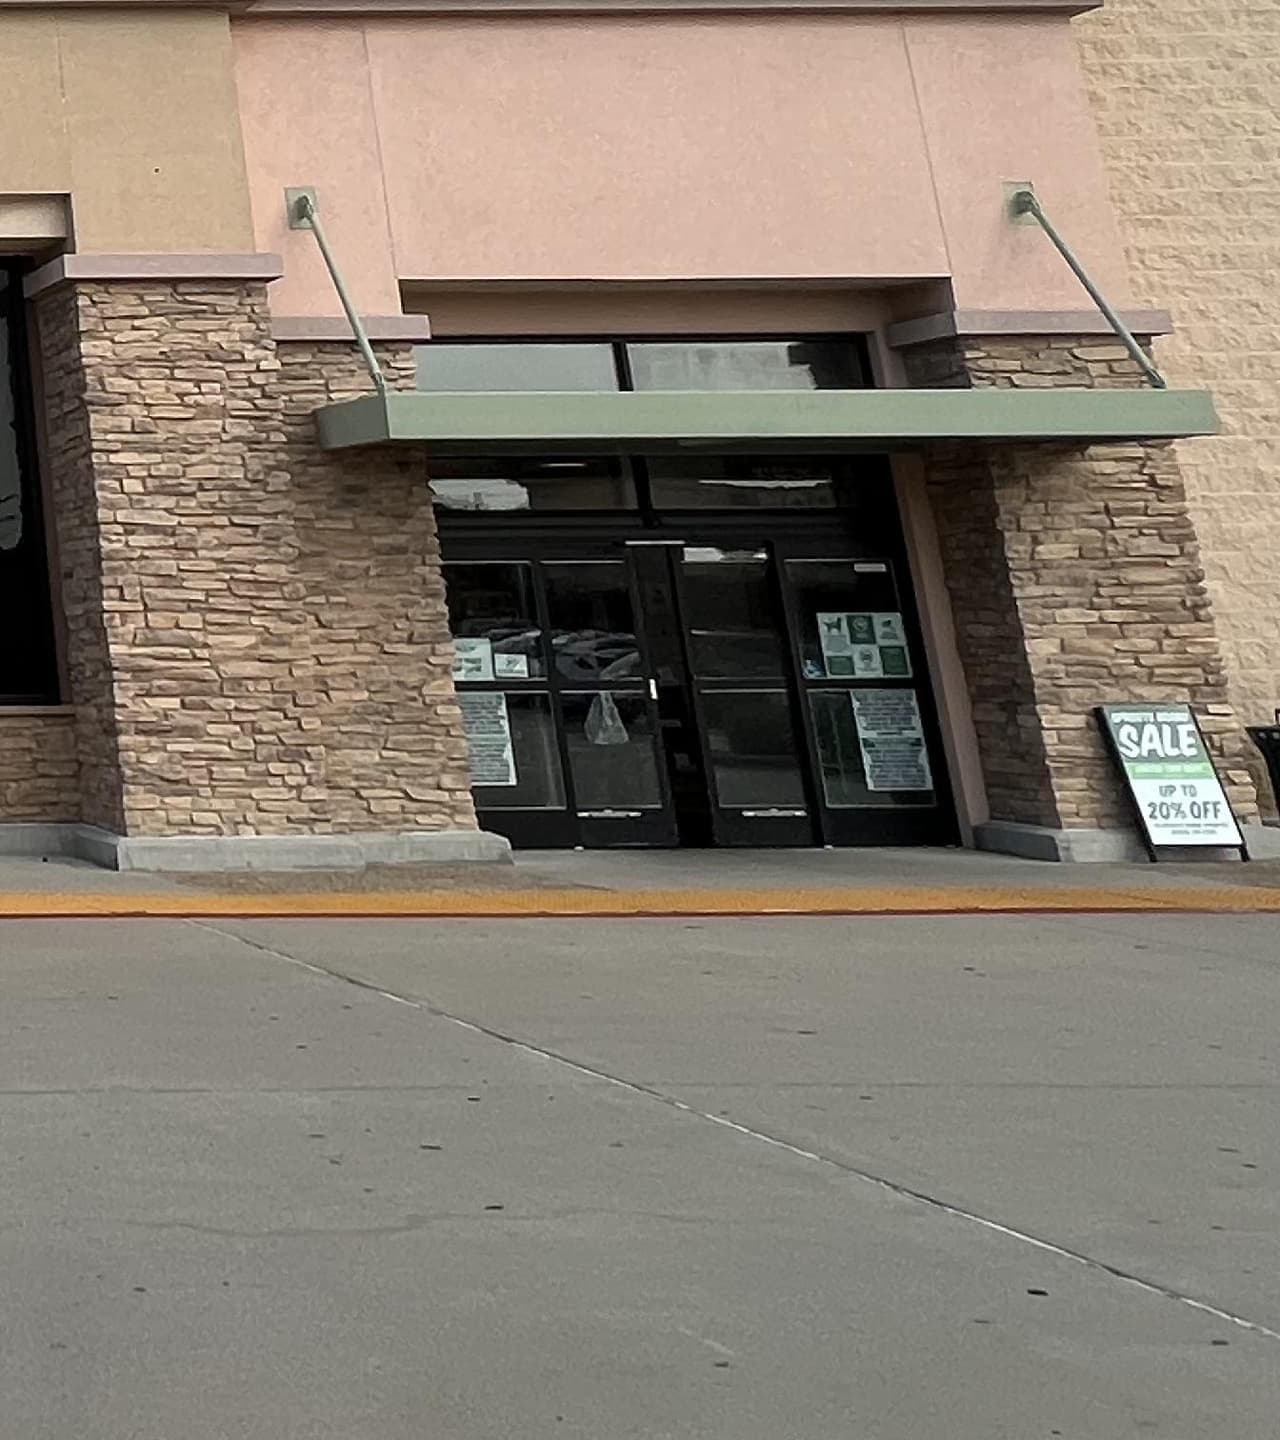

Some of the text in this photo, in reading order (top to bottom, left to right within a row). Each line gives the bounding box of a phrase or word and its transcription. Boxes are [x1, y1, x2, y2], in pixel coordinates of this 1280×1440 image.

[1118, 723, 1198, 759] SALE
[1159, 784, 1198, 798] UP TO
[1147, 801, 1221, 820] 20% OFF
